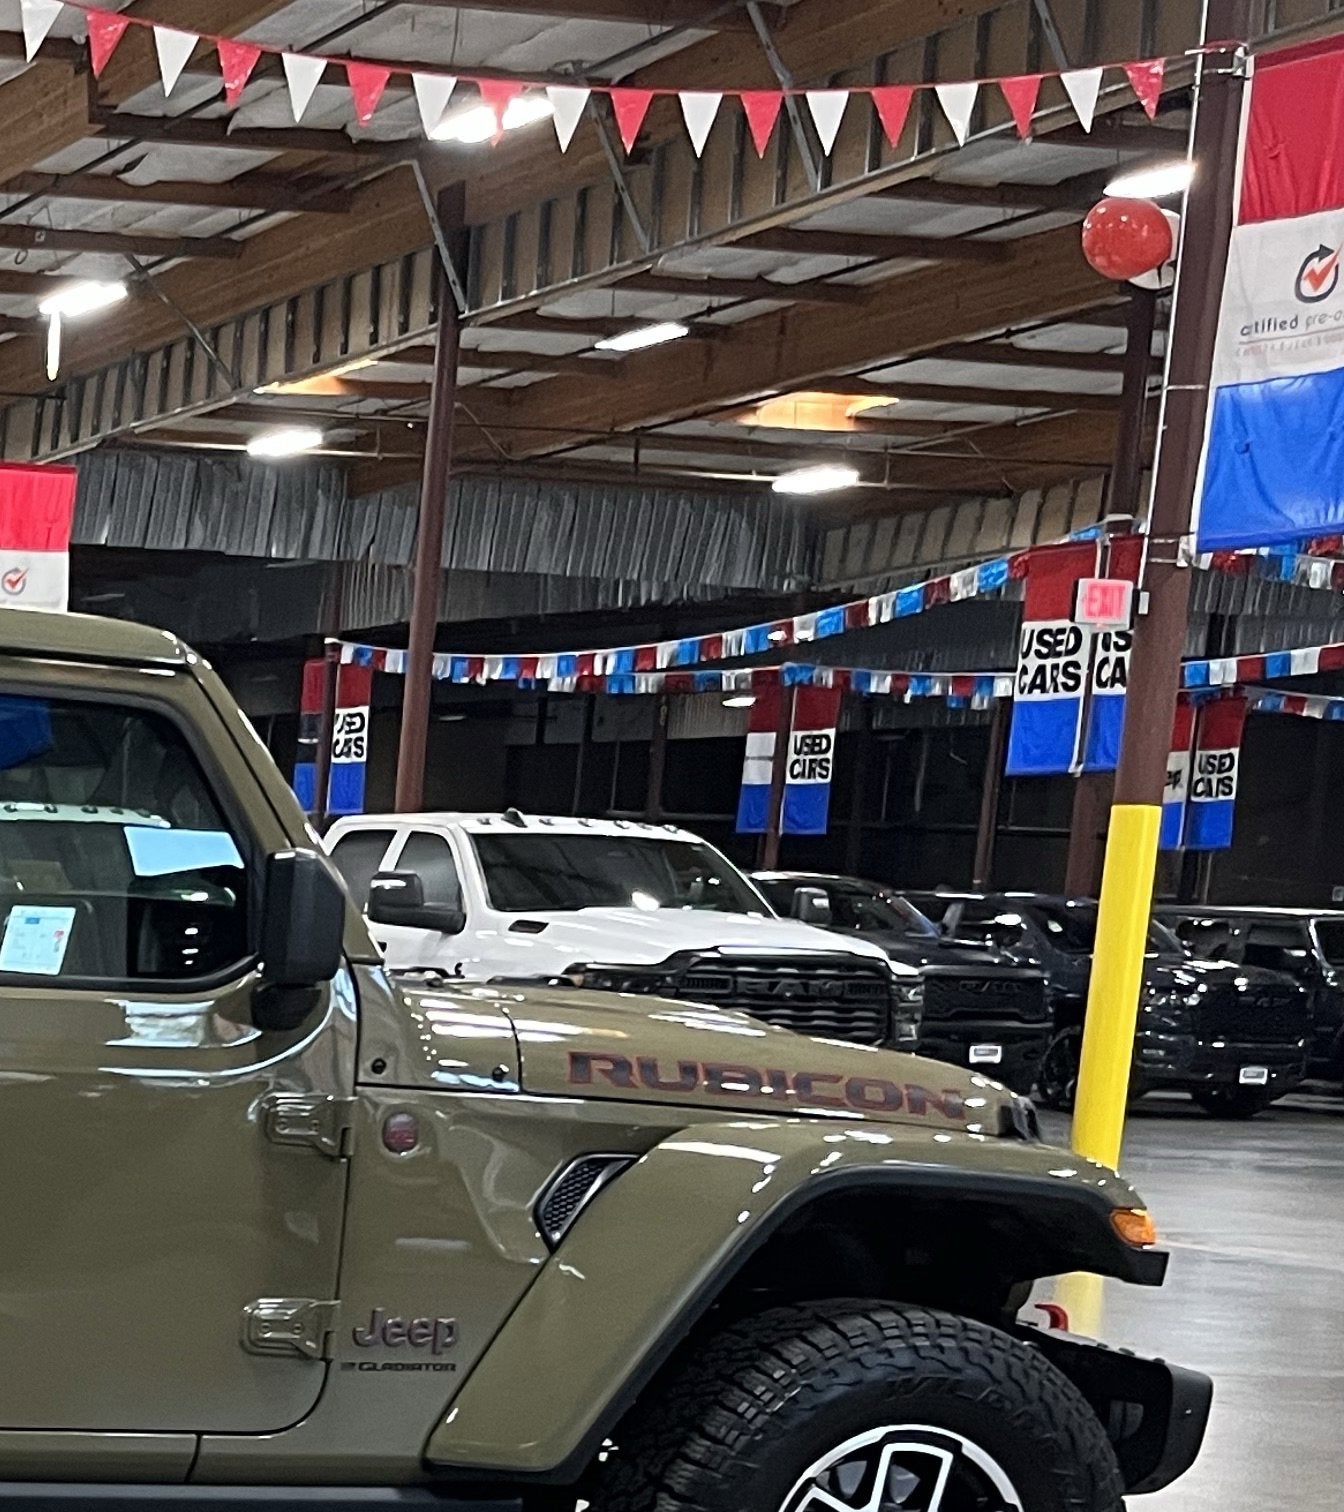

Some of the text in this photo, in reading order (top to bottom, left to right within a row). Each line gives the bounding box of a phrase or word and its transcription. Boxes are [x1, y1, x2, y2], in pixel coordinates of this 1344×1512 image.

[1240, 313, 1299, 337] ctified
[1084, 582, 1126, 619] EXIT
[1021, 626, 1083, 659] USED
[1018, 661, 1082, 694] CARS
[335, 712, 366, 735] UED
[333, 736, 365, 758] CS
[568, 1051, 966, 1120] RUBICON
[353, 1307, 459, 1356] Jeep
[358, 1361, 457, 1372] GLADIATOR
